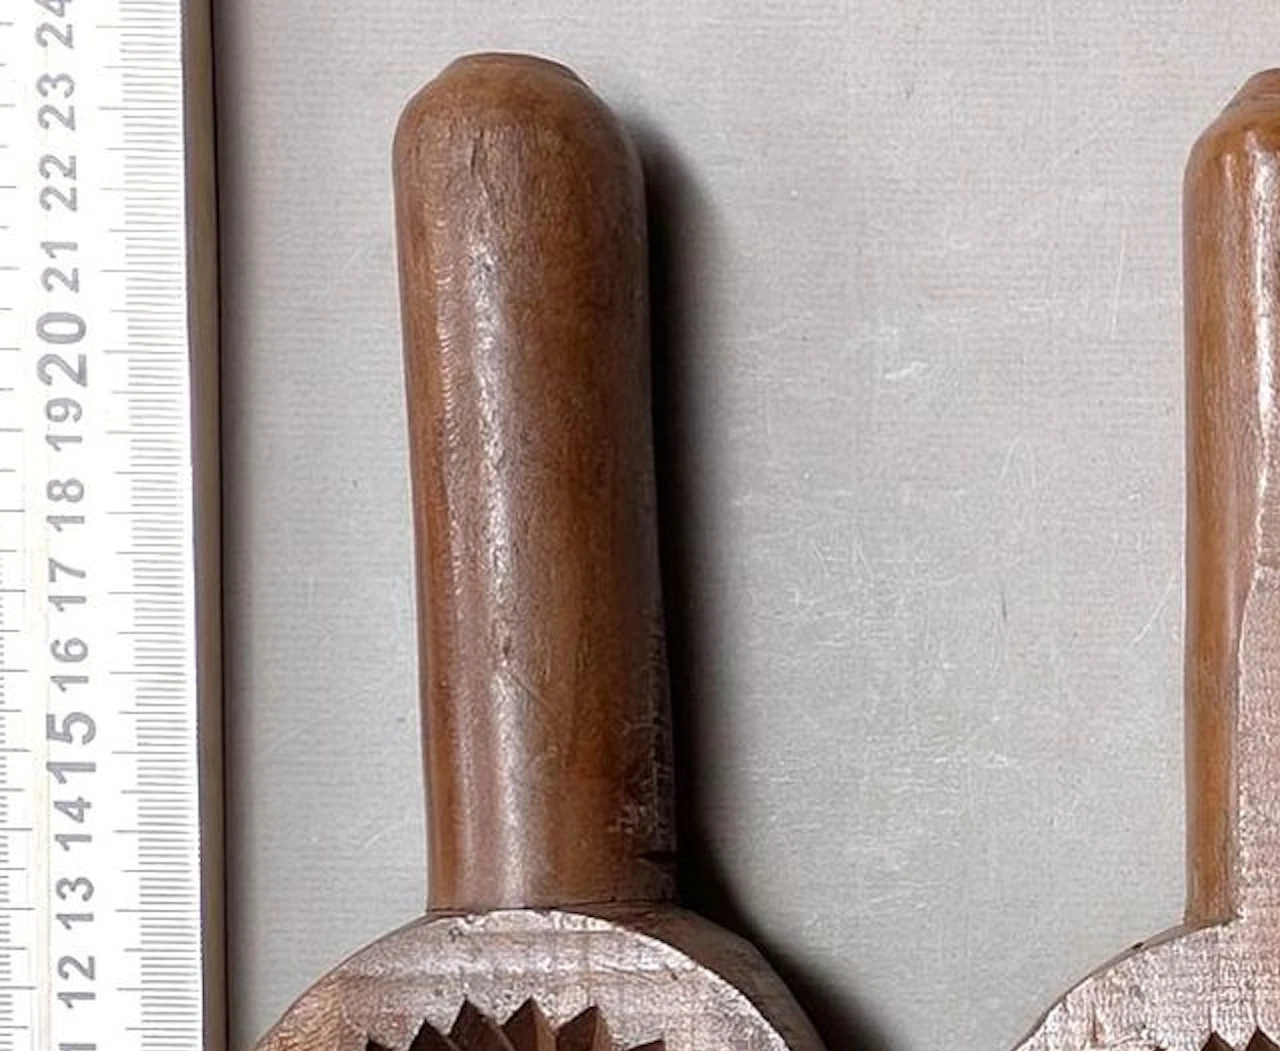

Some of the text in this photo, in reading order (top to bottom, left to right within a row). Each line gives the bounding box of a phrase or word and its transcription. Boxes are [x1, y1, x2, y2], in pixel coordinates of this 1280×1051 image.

[35, 72, 77, 132] 23
[38, 153, 79, 213] 22
[39, 240, 80, 294] 21
[35, 312, 88, 388] 20
[44, 397, 84, 453] 19
[45, 477, 86, 533] 18
[47, 556, 88, 613] 17
[49, 637, 90, 693] 16
[45, 711, 97, 785] 15
[52, 796, 93, 853] 14
[54, 876, 95, 931] 13
[56, 955, 97, 1010] 12
